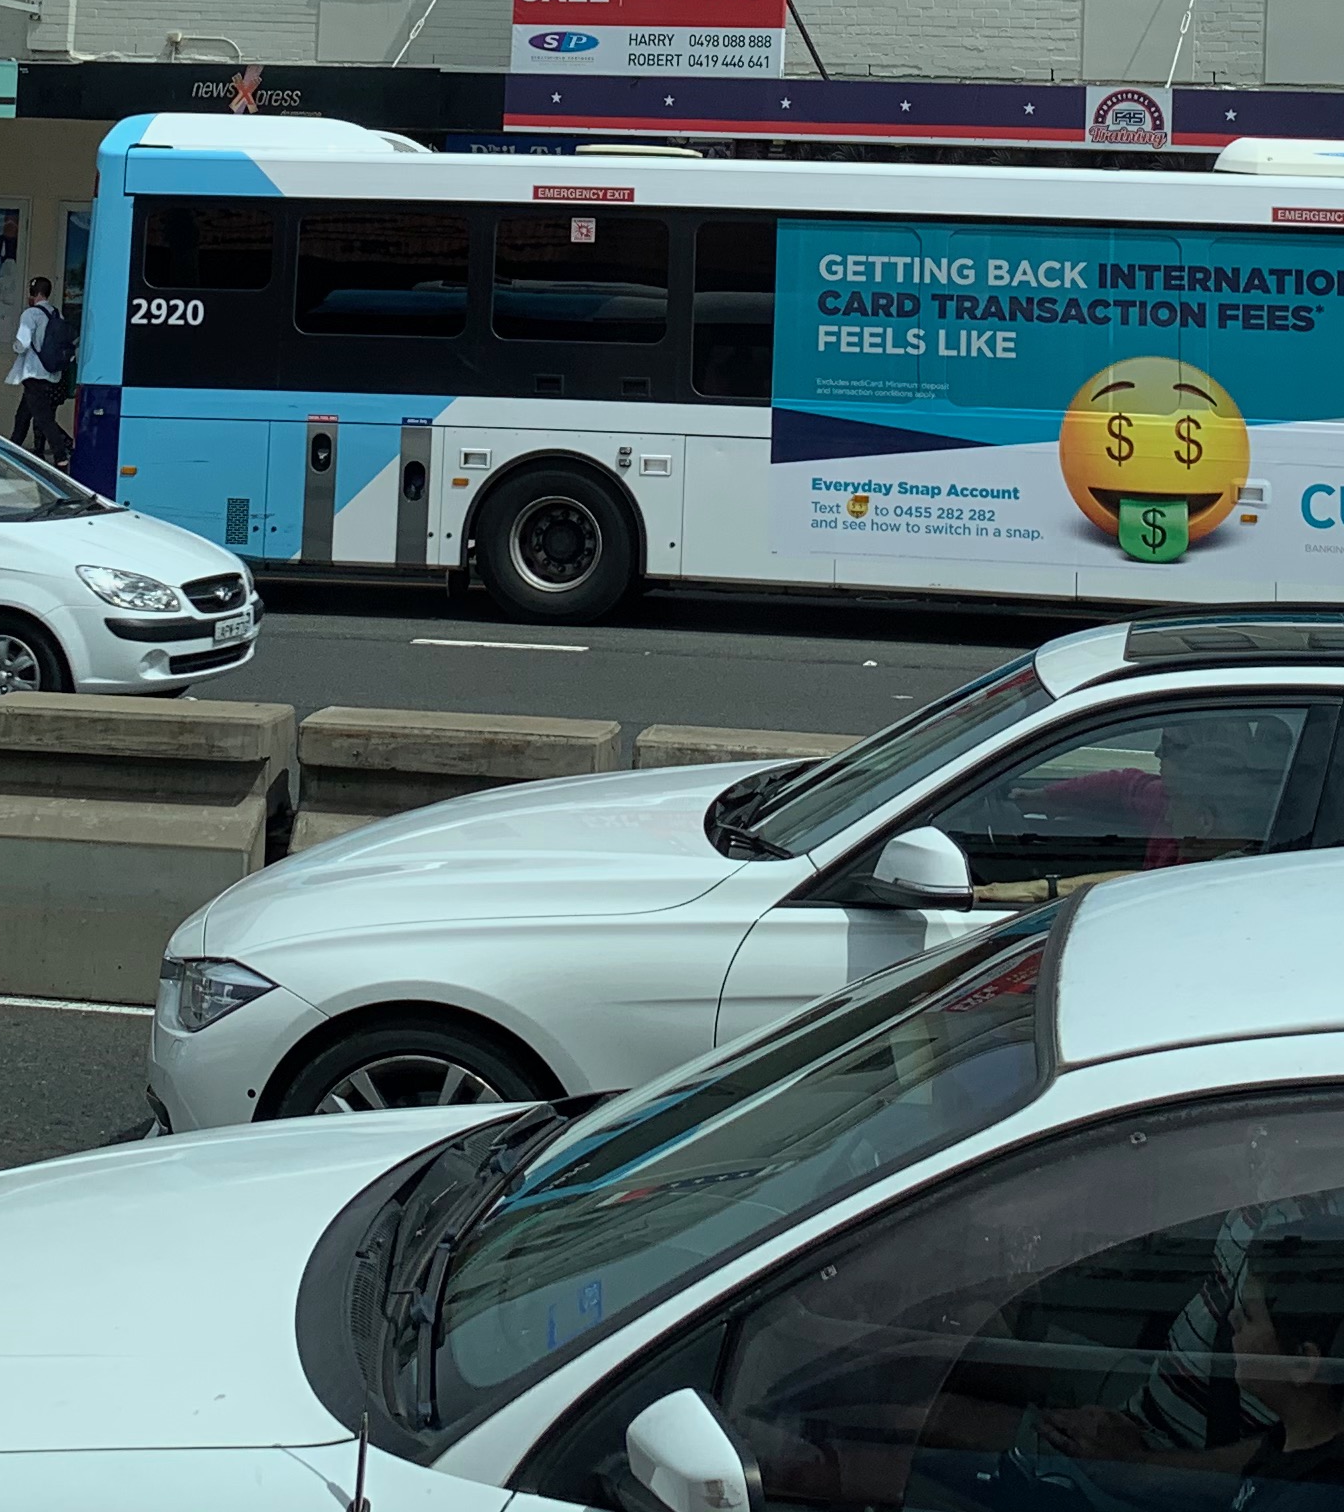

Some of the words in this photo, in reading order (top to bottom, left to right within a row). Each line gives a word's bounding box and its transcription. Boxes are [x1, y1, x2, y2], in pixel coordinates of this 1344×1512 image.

[629, 34, 675, 47] HARRY
[689, 34, 720, 47] 0498
[723, 35, 745, 48] 088
[748, 35, 771, 48] 888
[628, 54, 682, 66] ROBERT
[688, 55, 719, 67] 0419
[722, 55, 744, 68] 446
[748, 56, 769, 68] 641
[1112, 109, 1145, 125] F45
[1089, 125, 1167, 149] Training
[538, 189, 604, 200] EMERGENCY
[607, 190, 629, 200] EXIT
[819, 254, 975, 286] GETTING
[988, 259, 1088, 288] BACK
[131, 298, 204, 326] 2920
[818, 290, 920, 318] CARD
[931, 293, 1206, 329] TRANSACTION
[818, 325, 926, 355] FEELS
[938, 329, 1017, 359] LIKE
[832, 388, 873, 396] transaction
[875, 389, 912, 397] conditions
[811, 478, 893, 496] Everyday
[897, 482, 942, 499] Snap
[947, 484, 1020, 500] Account
[811, 501, 841, 514] Text
[874, 505, 889, 516] to
[894, 506, 932, 519] 0455
[937, 507, 964, 520] 282
[968, 508, 995, 522] 282
[811, 518, 838, 529] and
[842, 521, 866, 531] see
[871, 519, 901, 532] how
[906, 522, 920, 534] to
[925, 523, 971, 536] switch
[976, 524, 988, 537] in
[993, 528, 1001, 537] a
[1006, 528, 1044, 541] snap.
